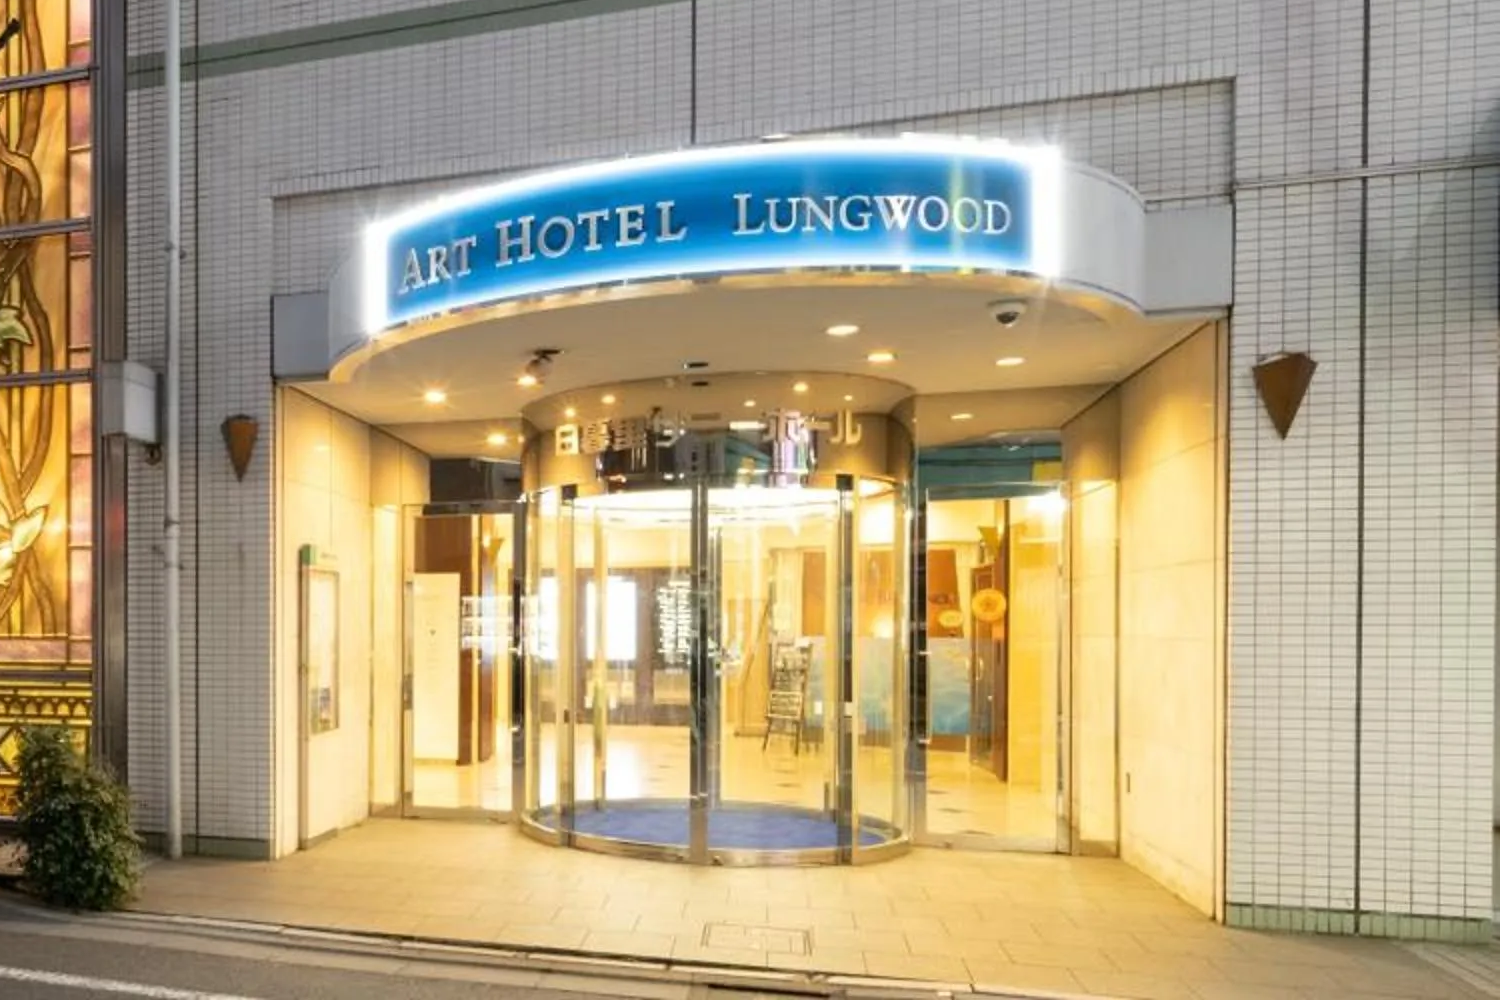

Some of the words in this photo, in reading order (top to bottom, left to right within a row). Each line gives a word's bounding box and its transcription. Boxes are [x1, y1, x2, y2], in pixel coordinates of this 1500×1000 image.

[399, 235, 477, 294] ART
[494, 200, 688, 267] HOTEL
[731, 192, 1012, 236] LUNGWOOD
